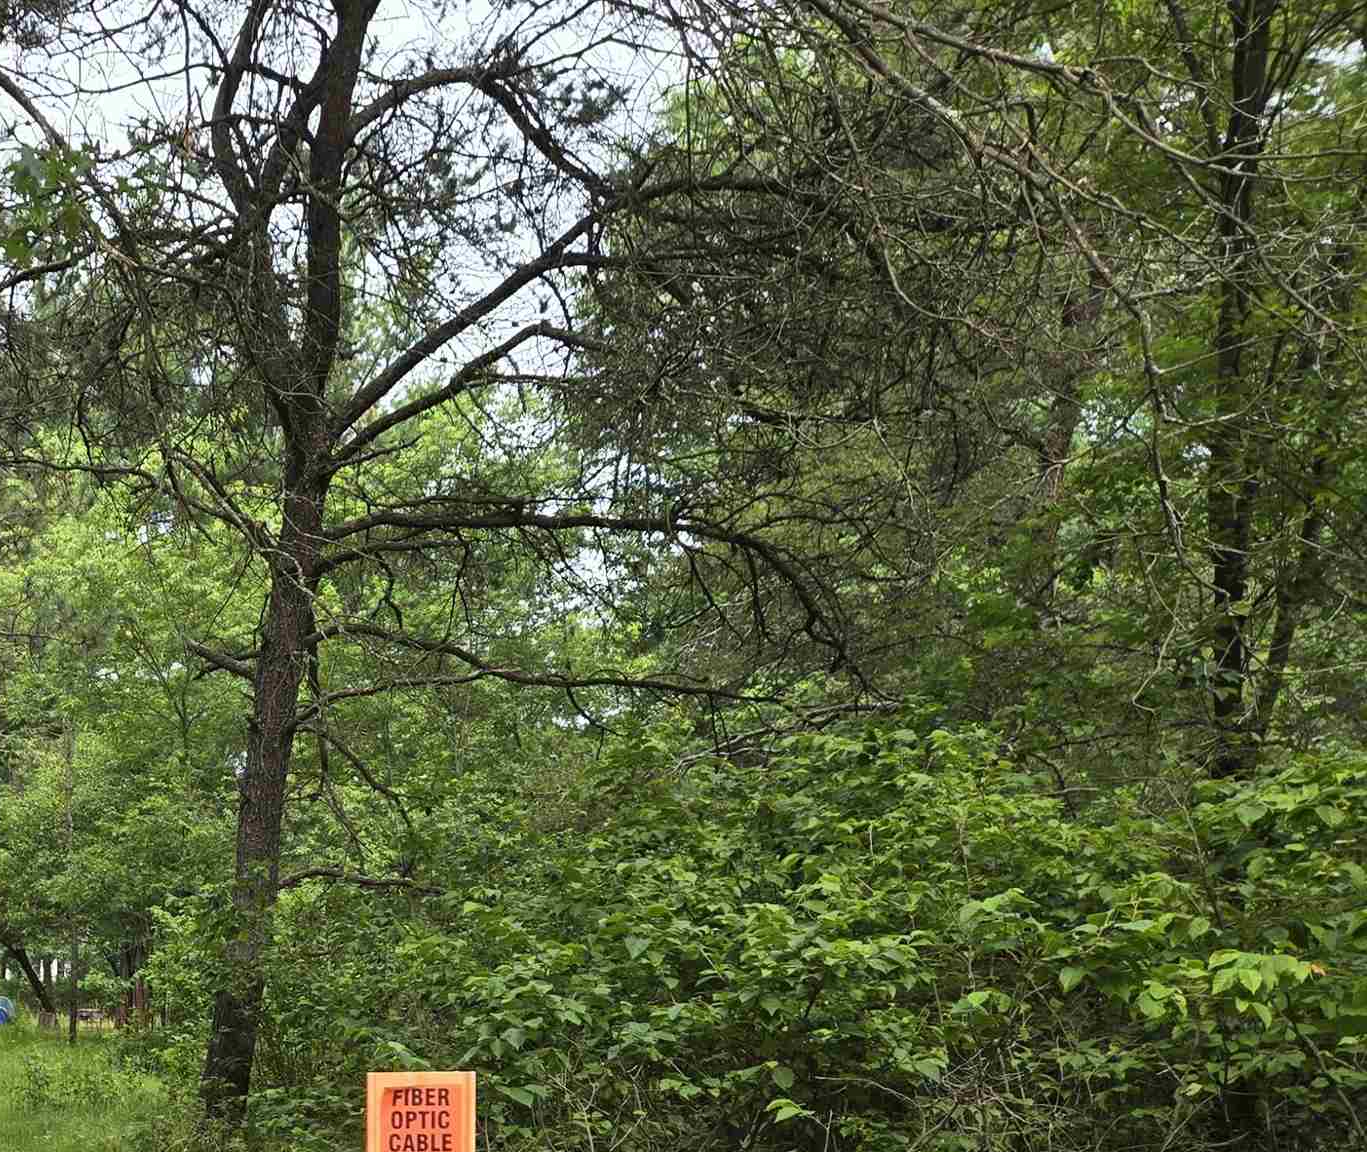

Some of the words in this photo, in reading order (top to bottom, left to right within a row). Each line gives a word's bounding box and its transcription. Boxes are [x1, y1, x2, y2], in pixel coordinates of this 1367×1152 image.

[391, 1088, 450, 1106] FIBER
[391, 1110, 450, 1129] OPTIC
[388, 1133, 453, 1152] CABLE
